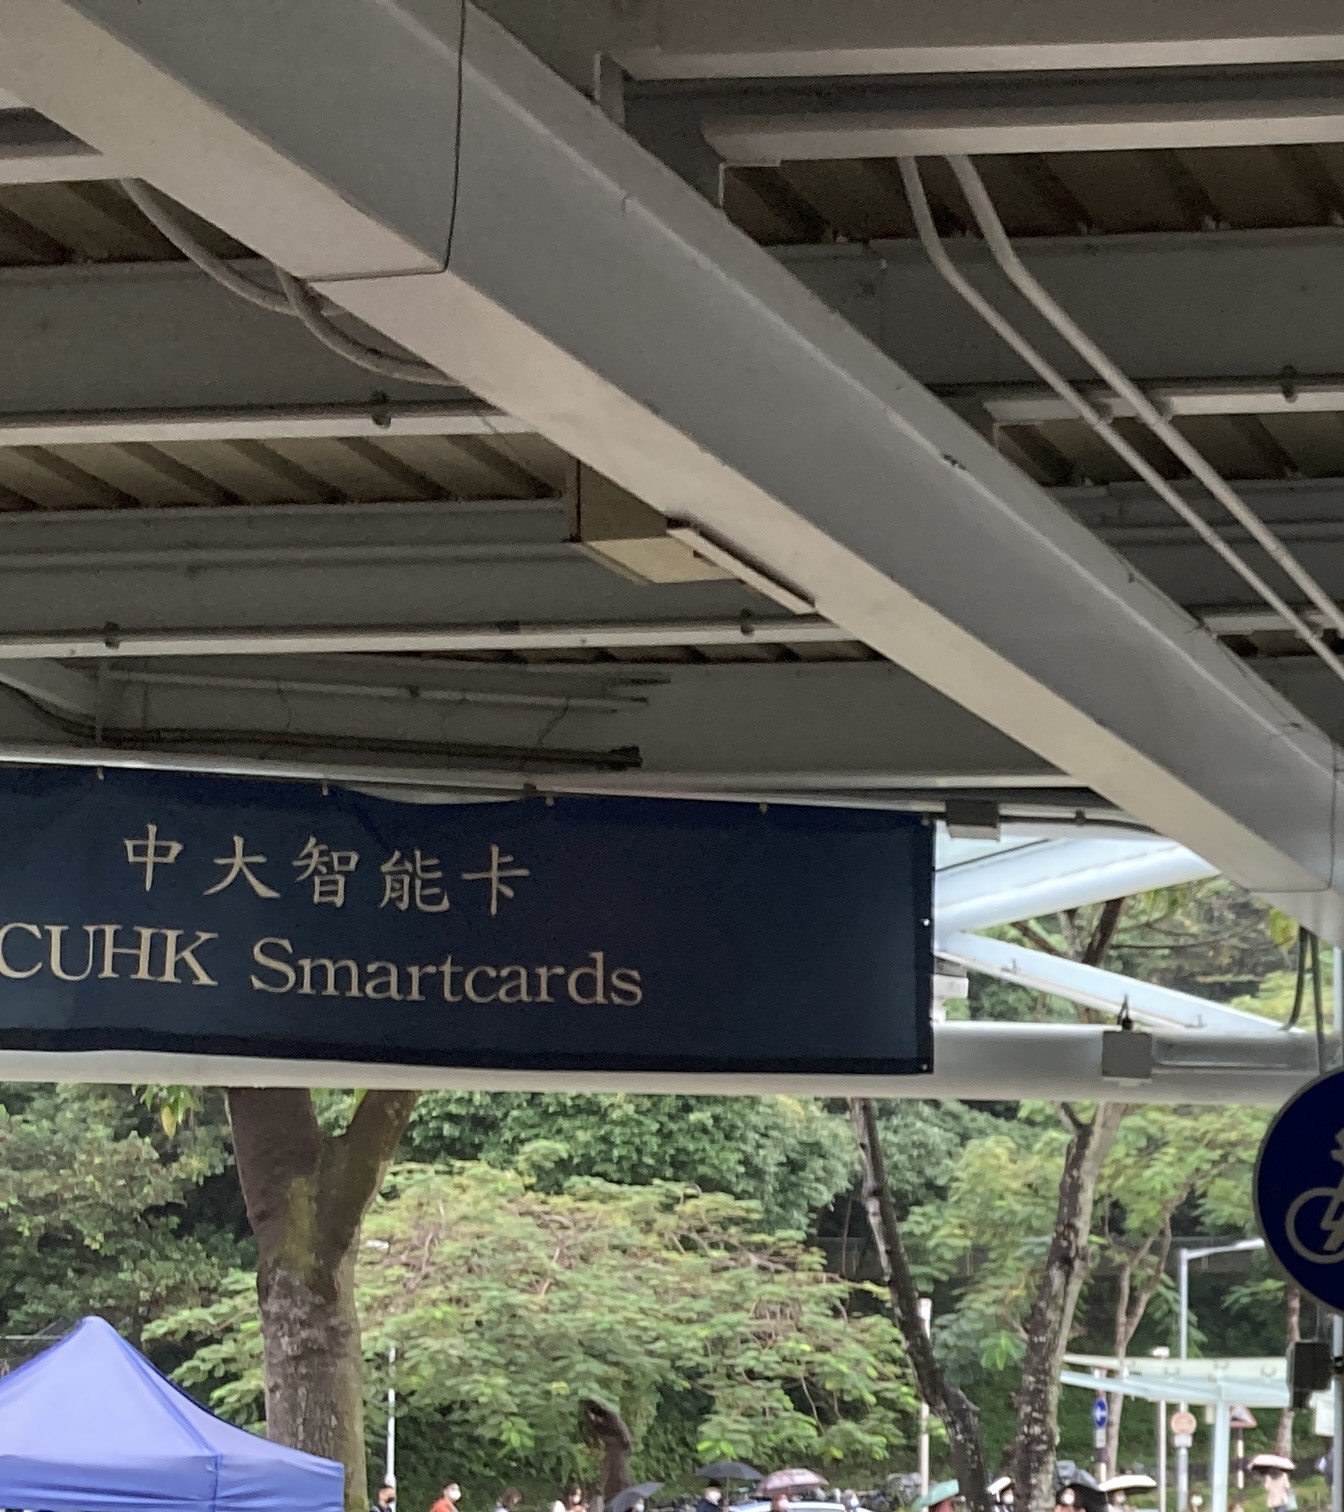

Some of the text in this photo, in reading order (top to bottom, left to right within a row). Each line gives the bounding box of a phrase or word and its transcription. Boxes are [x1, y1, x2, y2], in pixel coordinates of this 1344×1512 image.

[123, 823, 531, 917] 中大智能卡
[0, 922, 644, 1007] CUHK Smartcards
